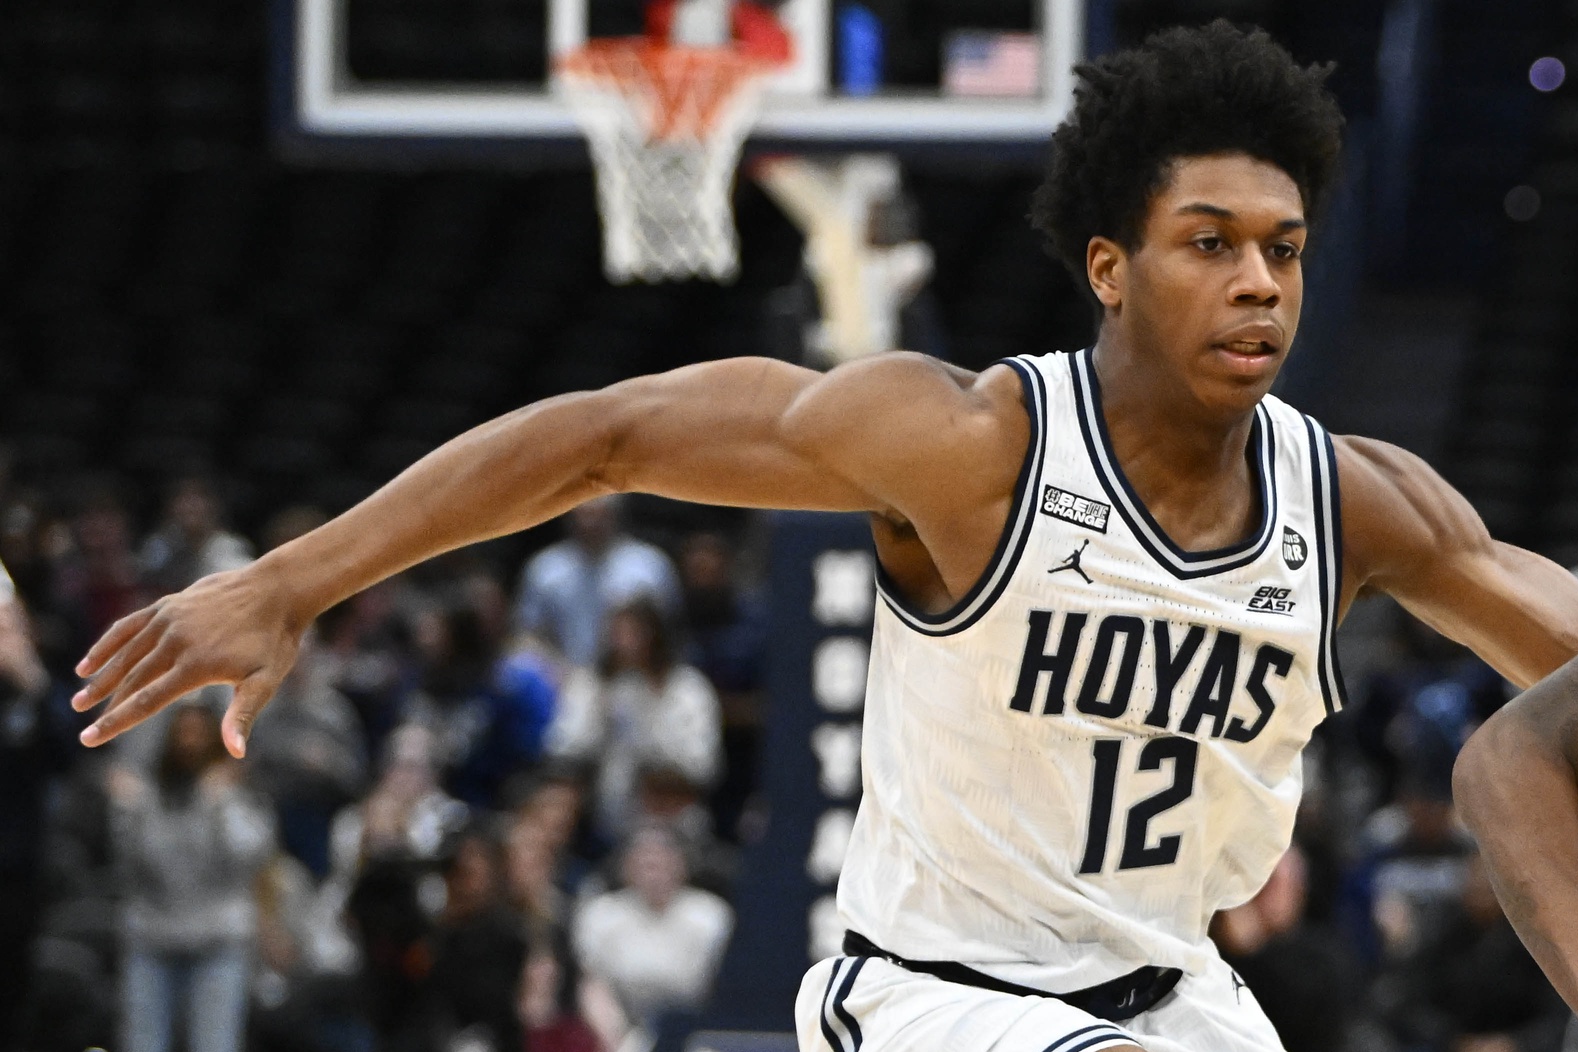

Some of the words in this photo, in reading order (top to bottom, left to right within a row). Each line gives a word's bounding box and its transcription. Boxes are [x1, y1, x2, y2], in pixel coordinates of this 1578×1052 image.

[1043, 501, 1106, 529] CHANGE
[1248, 597, 1296, 612] EAST
[1254, 586, 1292, 599] BIG
[1008, 608, 1295, 744] HOYAS
[1074, 735, 1201, 877] 12
